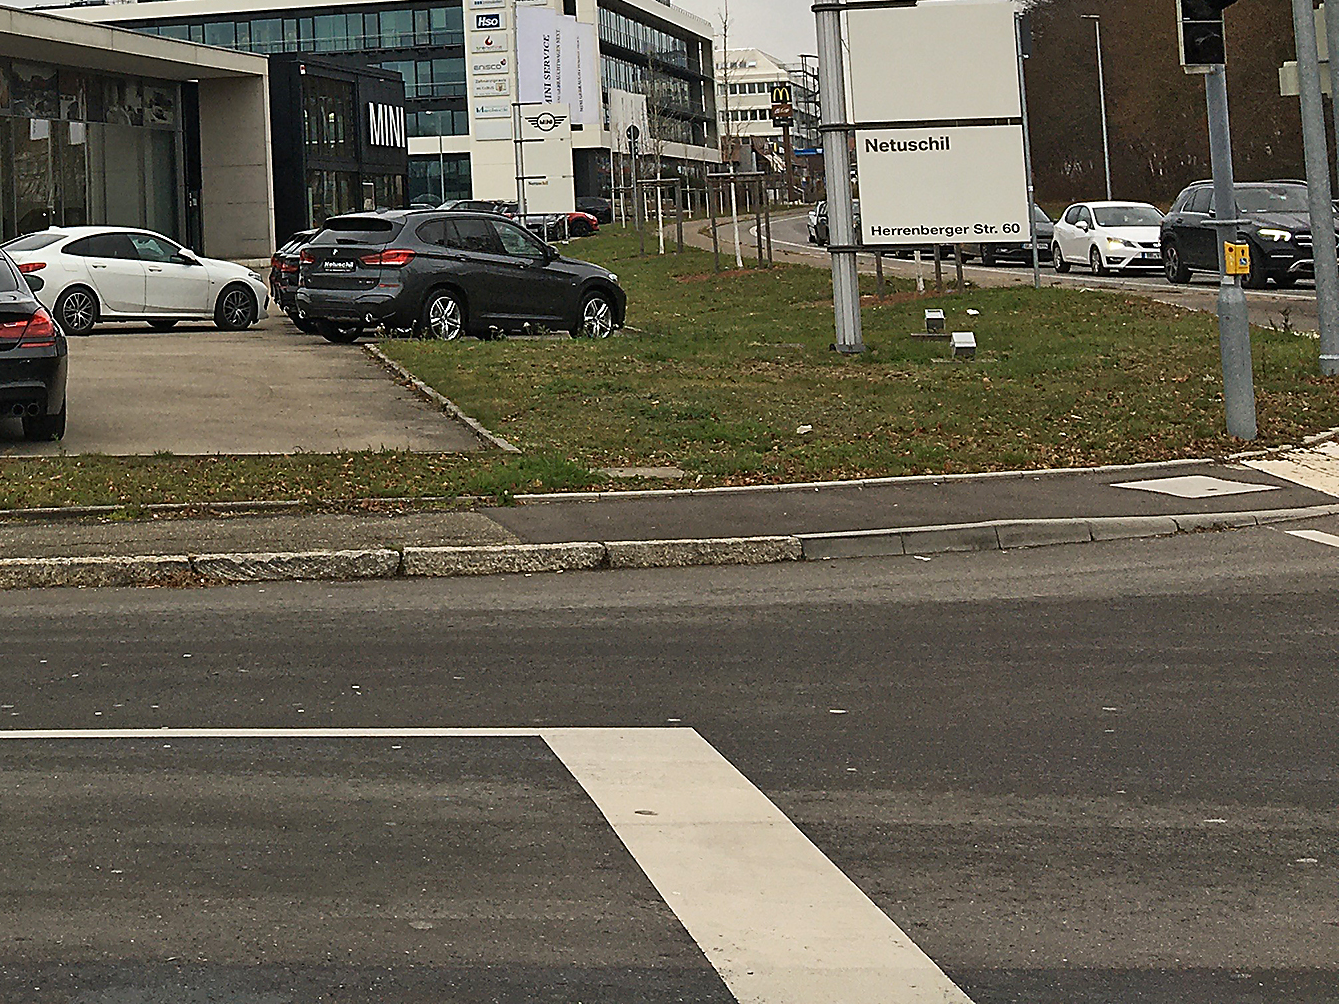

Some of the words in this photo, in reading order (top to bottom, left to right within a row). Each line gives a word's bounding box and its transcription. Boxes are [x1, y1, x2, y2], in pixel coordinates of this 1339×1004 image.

[542, 34, 552, 80] SERVICE
[368, 101, 406, 148] MINI
[865, 136, 951, 153] Netuschil
[871, 225, 970, 237] Herrenberger
[973, 223, 998, 235] Str.
[1002, 223, 1021, 234] 60
